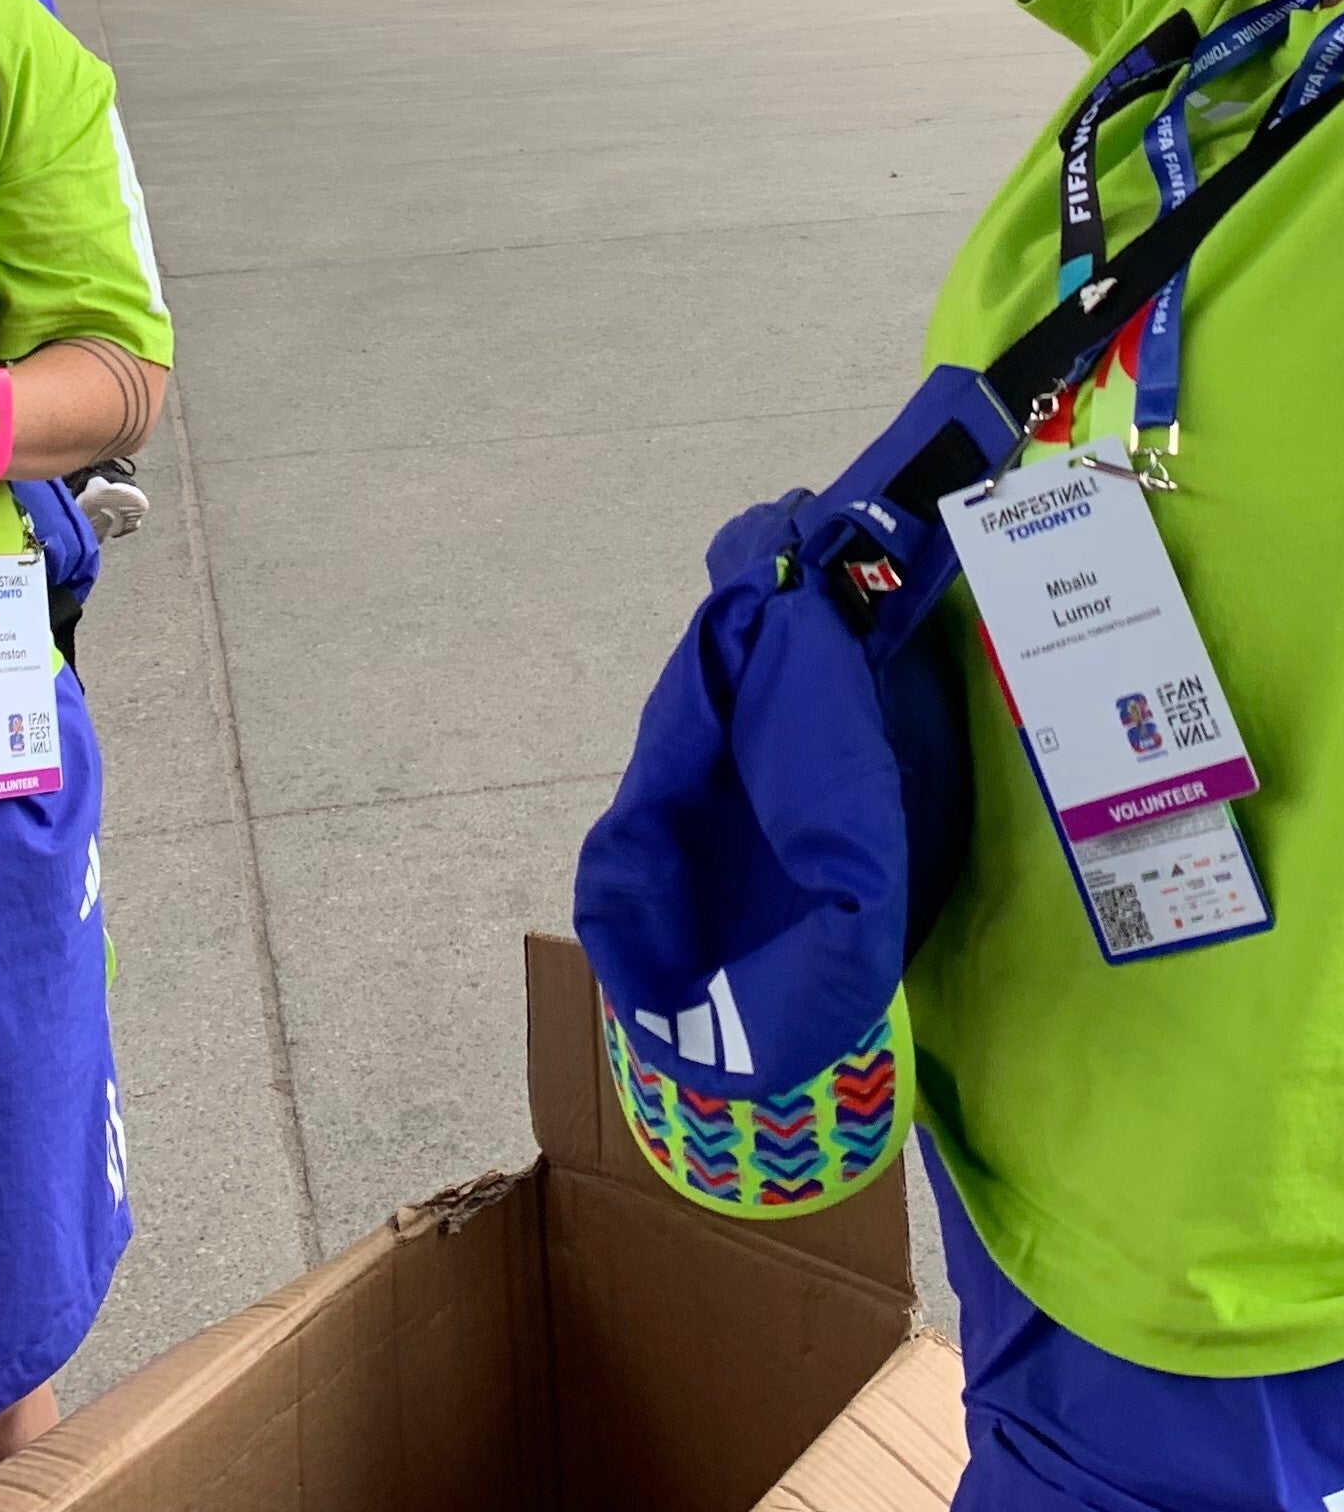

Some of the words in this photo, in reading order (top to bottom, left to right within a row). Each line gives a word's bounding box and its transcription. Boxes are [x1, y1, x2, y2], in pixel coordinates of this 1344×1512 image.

[1315, 39, 1344, 74] FAN
[1070, 95, 1106, 152] WO
[1066, 151, 1092, 225] FIFA
[1006, 502, 1092, 543] TORONTO
[1045, 569, 1099, 600] Mbalu
[1052, 594, 1113, 628] Lumor
[1108, 780, 1208, 823] VOLUNTEER
